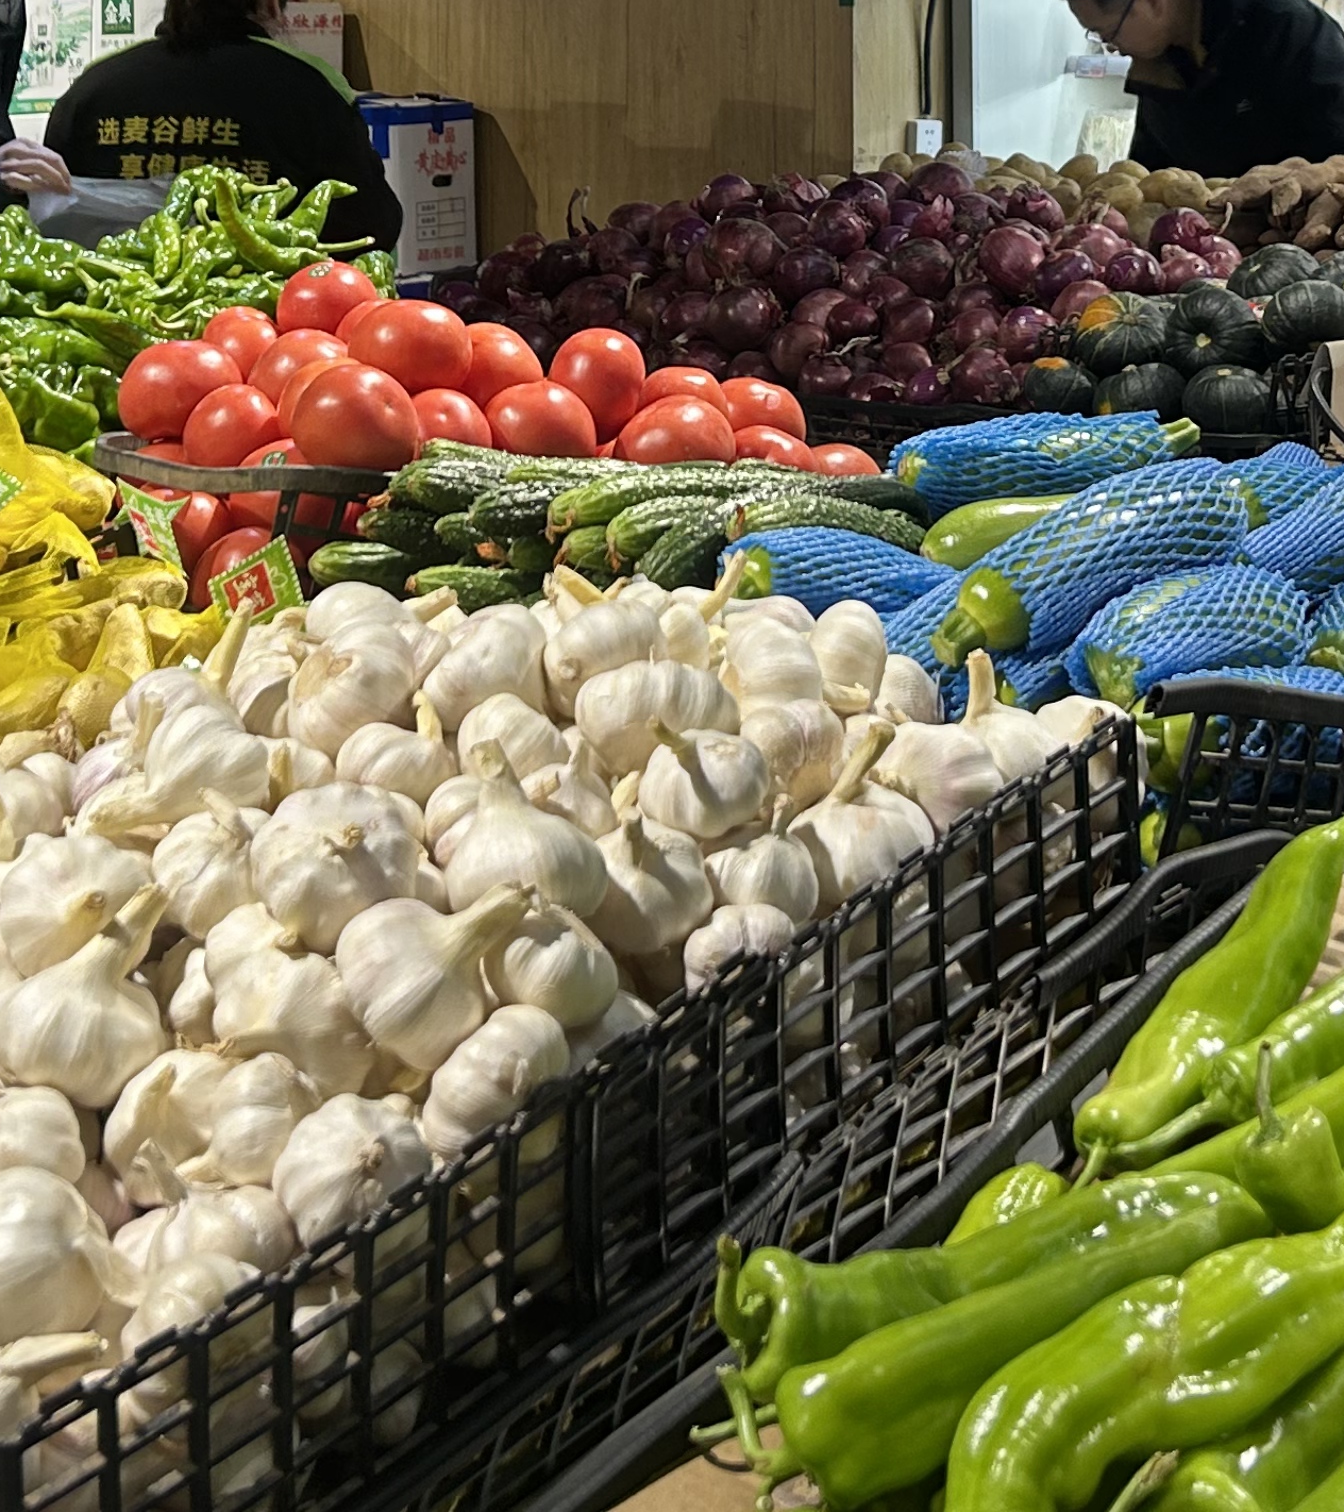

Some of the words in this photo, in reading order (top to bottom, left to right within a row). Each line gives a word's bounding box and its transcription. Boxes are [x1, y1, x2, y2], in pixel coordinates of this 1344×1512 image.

[98, 115, 241, 147] 选麦谷鲜生
